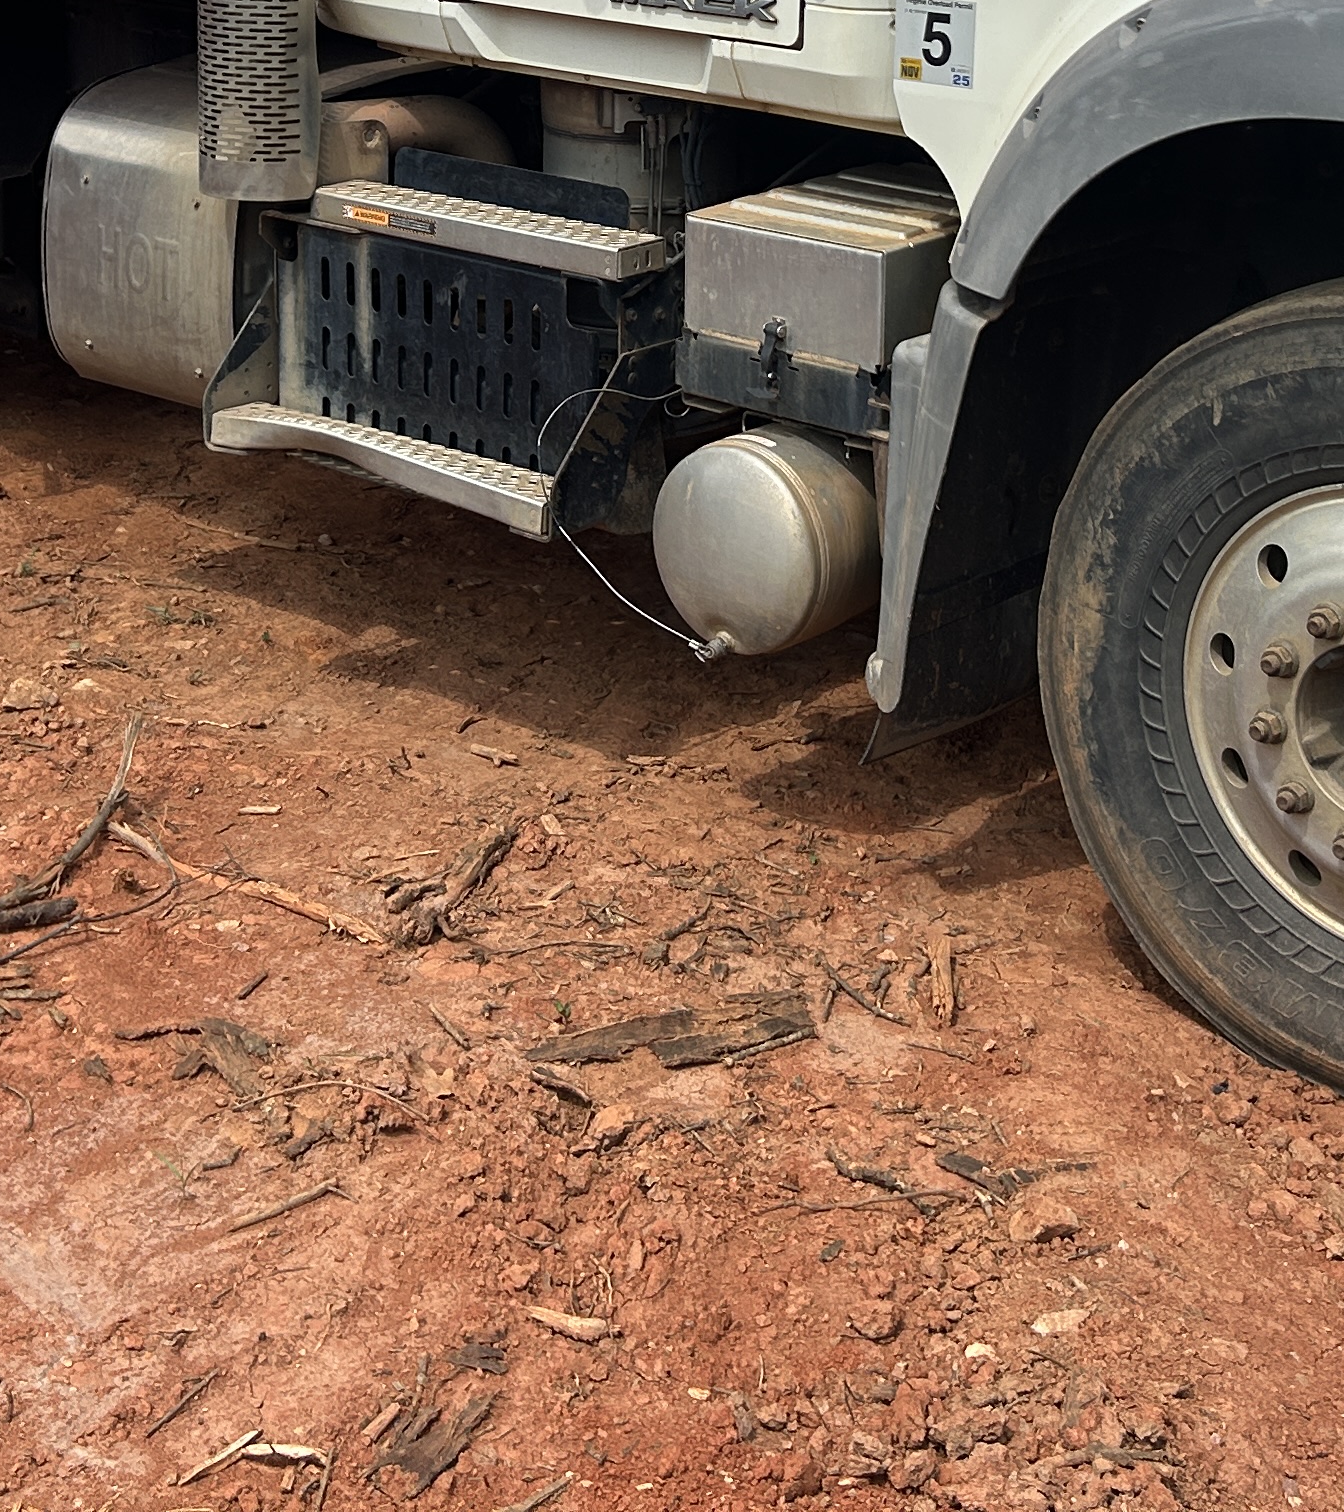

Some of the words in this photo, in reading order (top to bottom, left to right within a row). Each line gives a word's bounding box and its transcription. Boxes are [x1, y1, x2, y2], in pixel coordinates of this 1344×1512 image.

[955, 1, 974, 11] Permit
[922, 12, 952, 67] 5
[901, 64, 920, 79] NOV
[953, 74, 970, 87] 25
[98, 223, 180, 302] HOT
